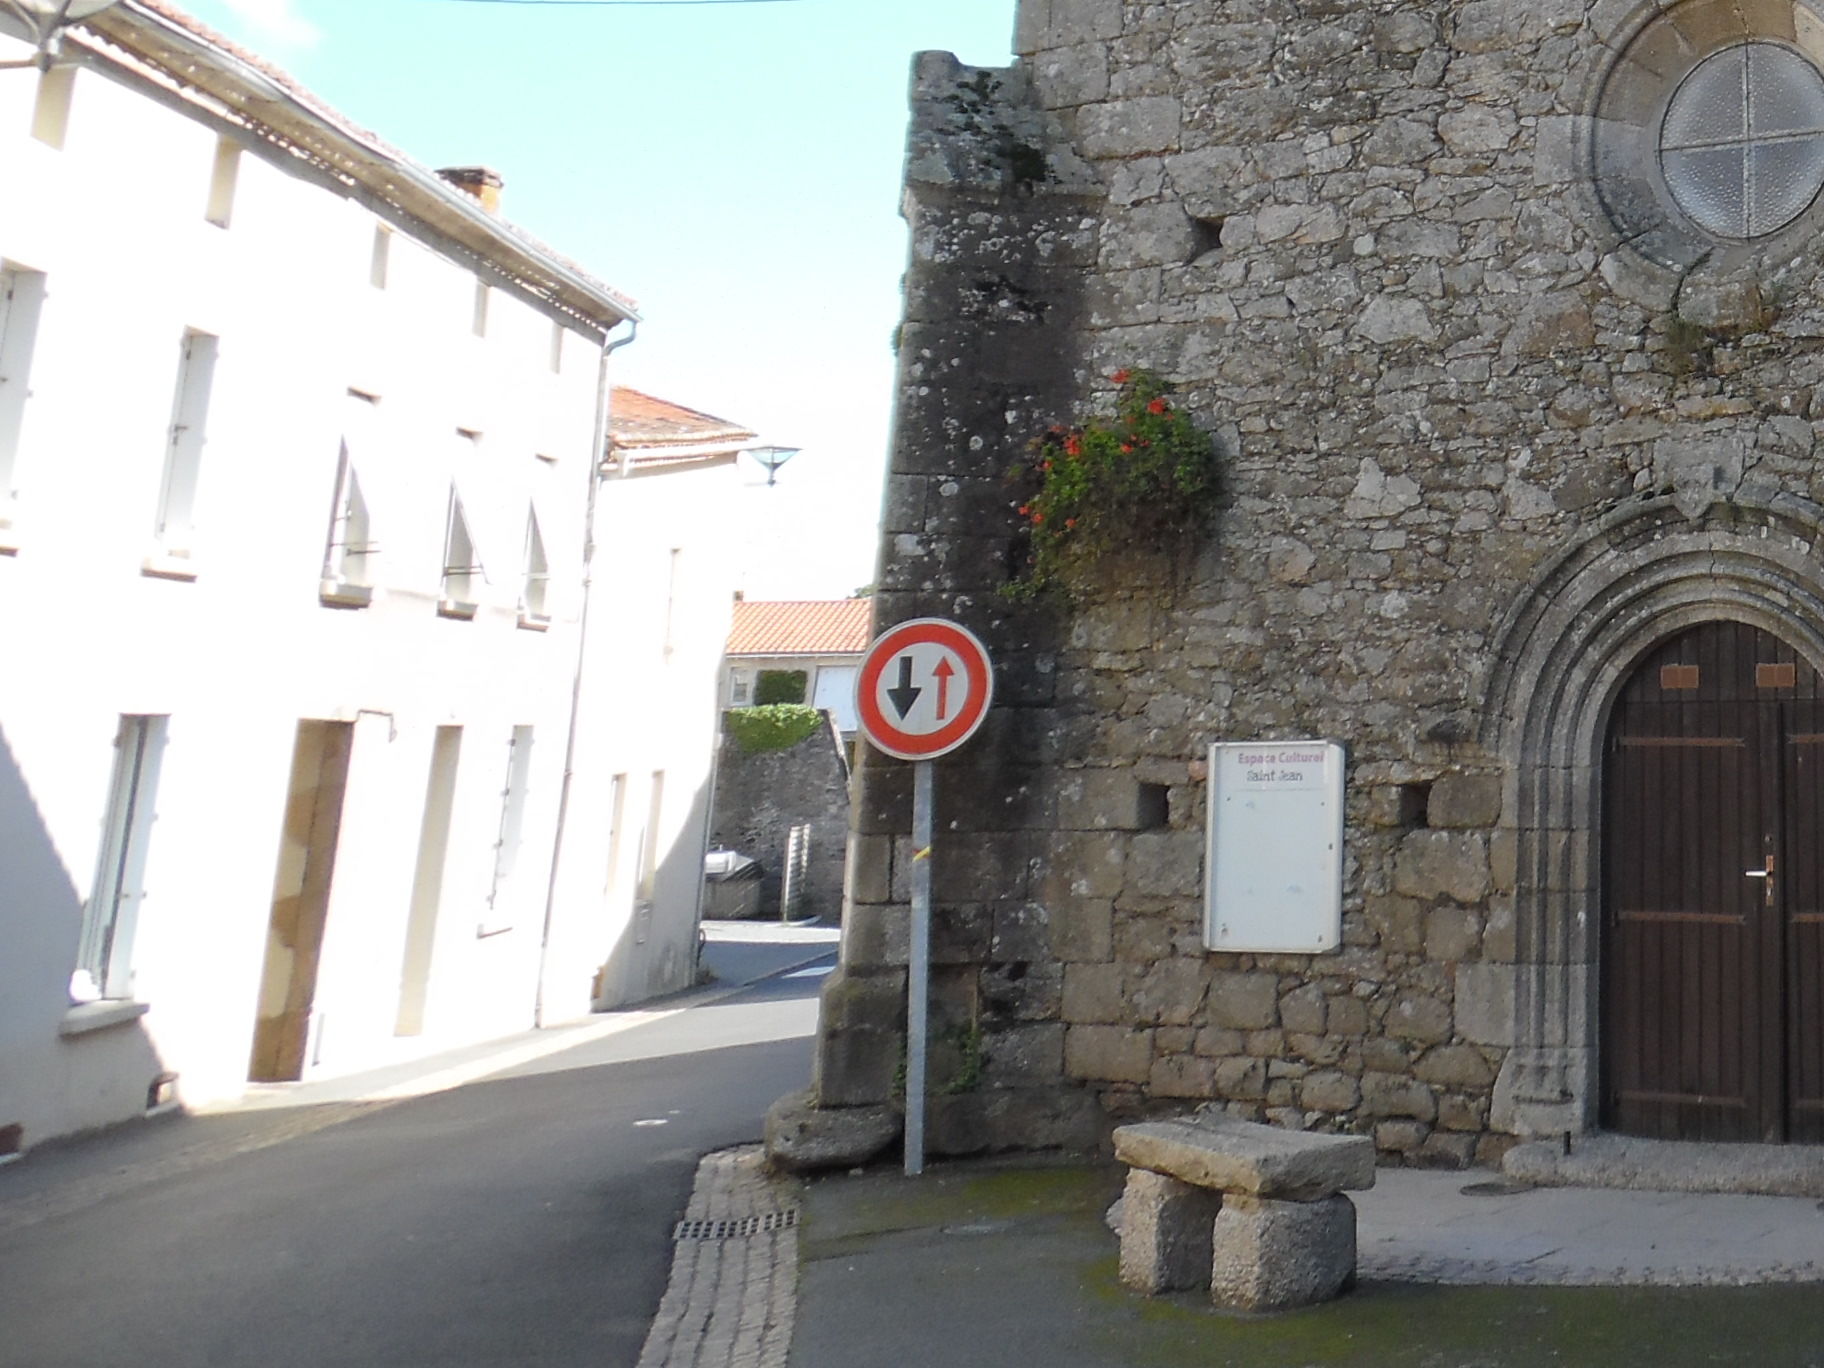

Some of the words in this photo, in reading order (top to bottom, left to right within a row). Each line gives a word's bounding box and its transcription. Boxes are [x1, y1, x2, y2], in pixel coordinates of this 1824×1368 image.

[1238, 752, 1276, 766] Espace
[1279, 750, 1325, 764] Culturel
[1246, 770, 1275, 782] Saint
[1279, 769, 1303, 781] Jean
